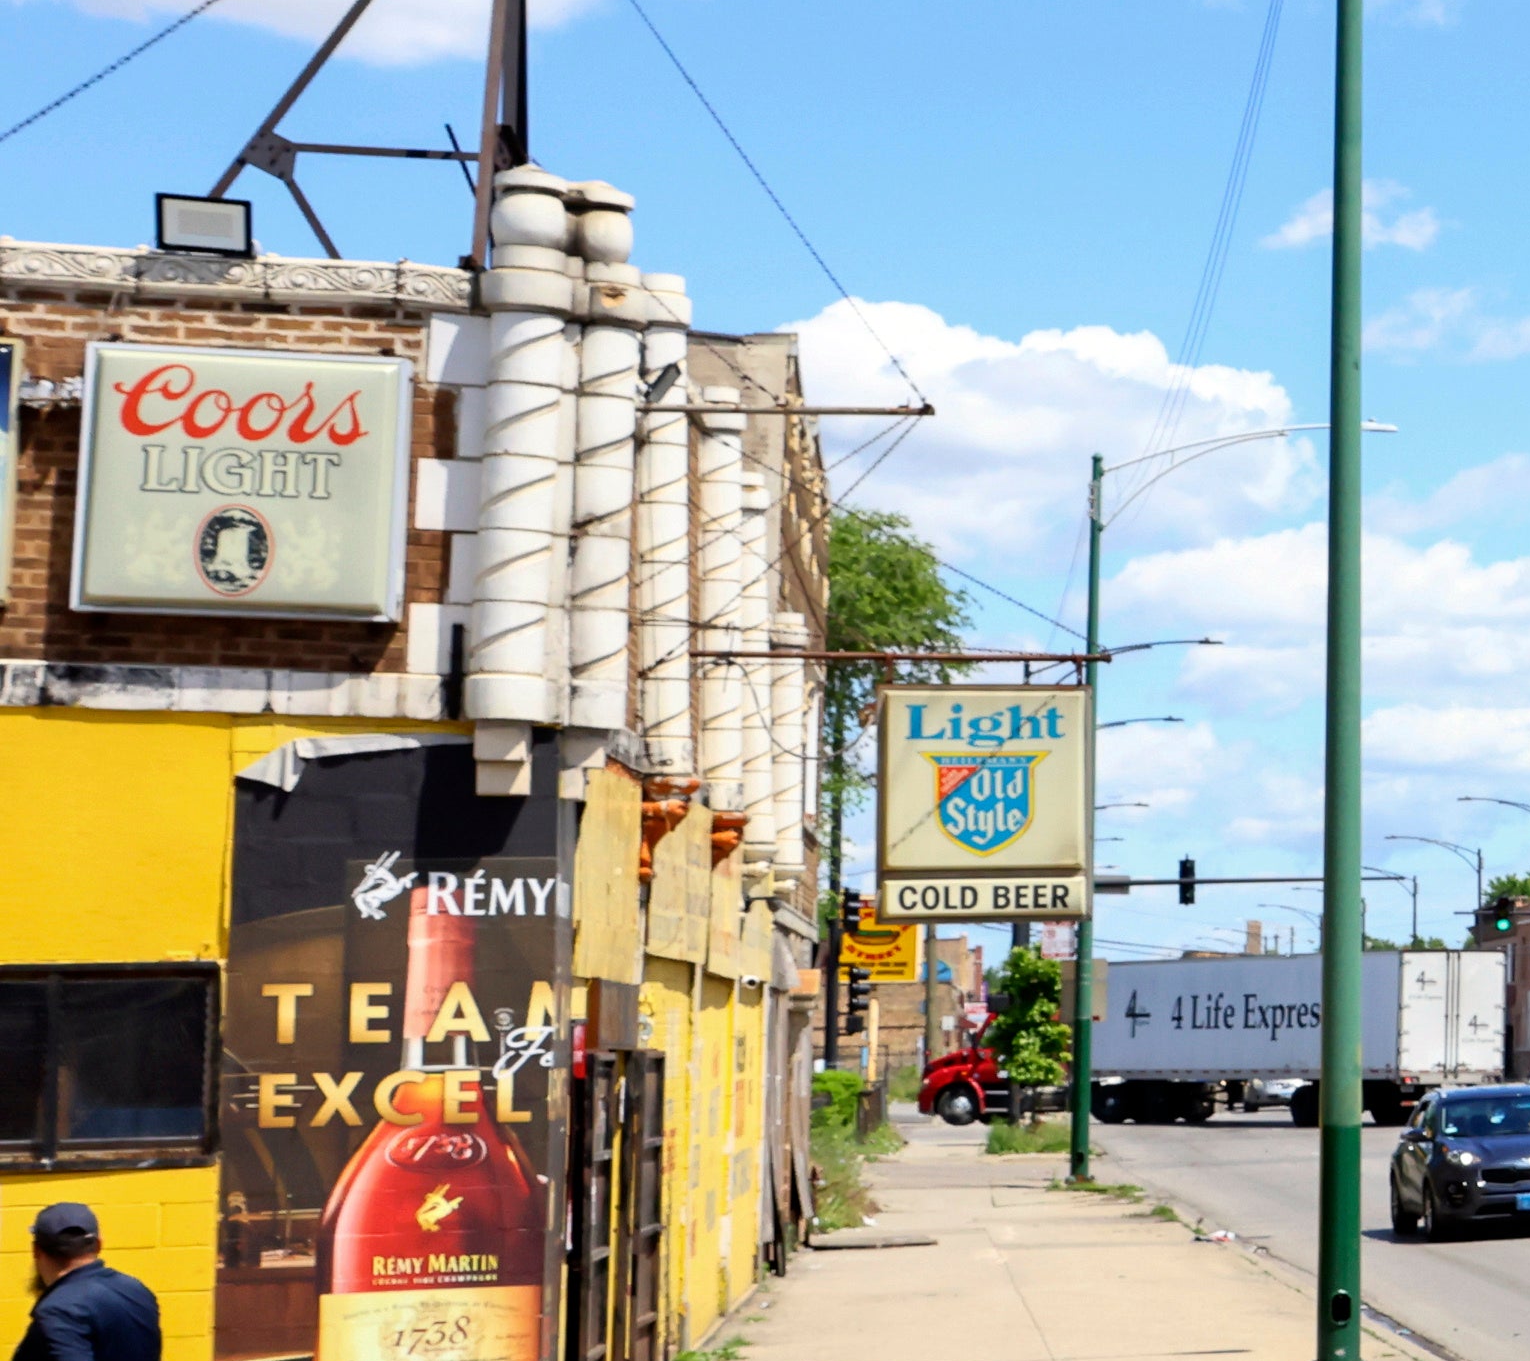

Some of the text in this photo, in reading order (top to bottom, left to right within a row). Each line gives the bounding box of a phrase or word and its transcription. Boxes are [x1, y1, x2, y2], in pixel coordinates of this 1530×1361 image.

[113, 363, 370, 447] Coors
[140, 444, 342, 500] LIGHT
[905, 703, 1066, 748] Light
[970, 768, 1023, 801] Old
[946, 796, 1023, 845] Style
[427, 869, 556, 917] RÉMY
[898, 884, 1069, 910] COLD BEER
[1171, 995, 1183, 1030] 4
[1190, 992, 1235, 1030] Life
[394, 1315, 471, 1355] 1738
